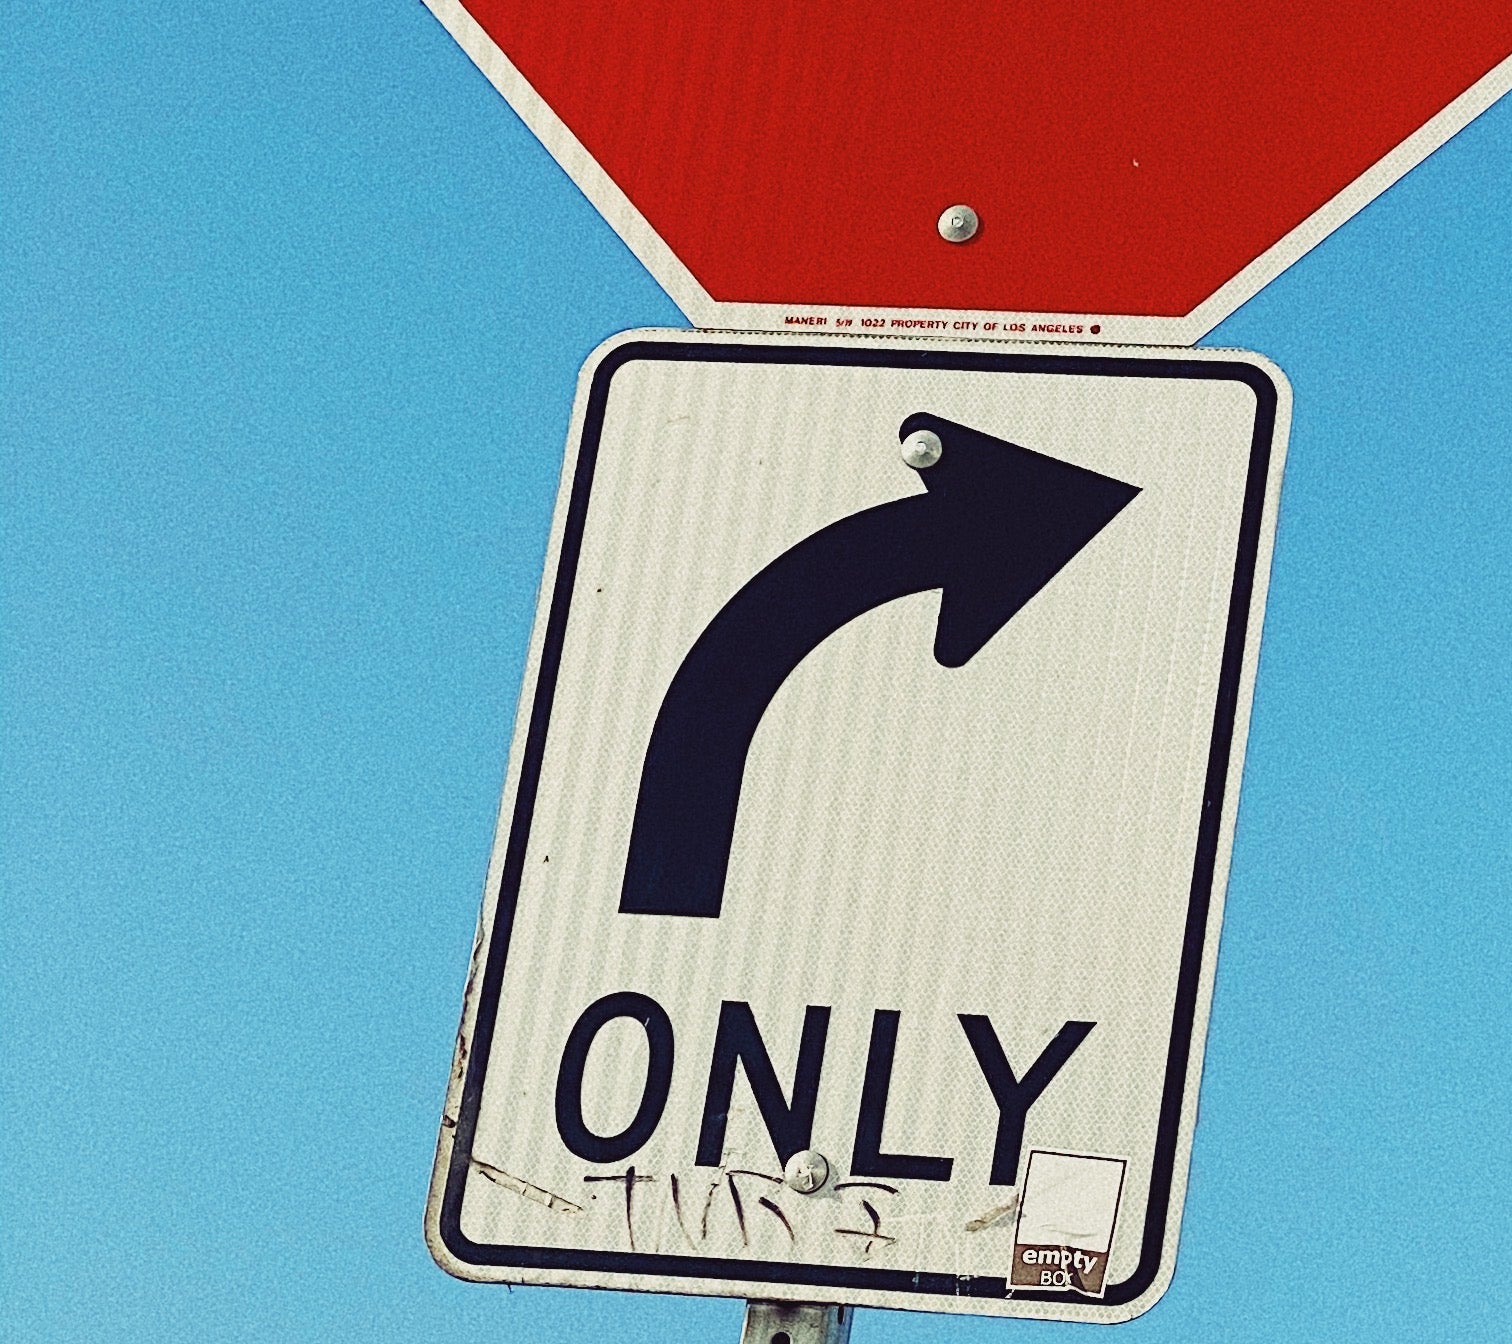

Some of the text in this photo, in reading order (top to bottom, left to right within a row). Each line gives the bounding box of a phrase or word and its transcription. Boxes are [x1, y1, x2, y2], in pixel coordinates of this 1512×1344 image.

[784, 316, 828, 325] MANERI
[861, 318, 886, 328] 1022
[890, 319, 949, 329] PROPERTY
[953, 321, 979, 331] CITY
[983, 322, 999, 331] OF
[1003, 323, 1026, 332] LOS
[1031, 324, 1084, 334] ANGELES
[555, 991, 1097, 1186] ONLY
[1022, 1248, 1098, 1274] empty
